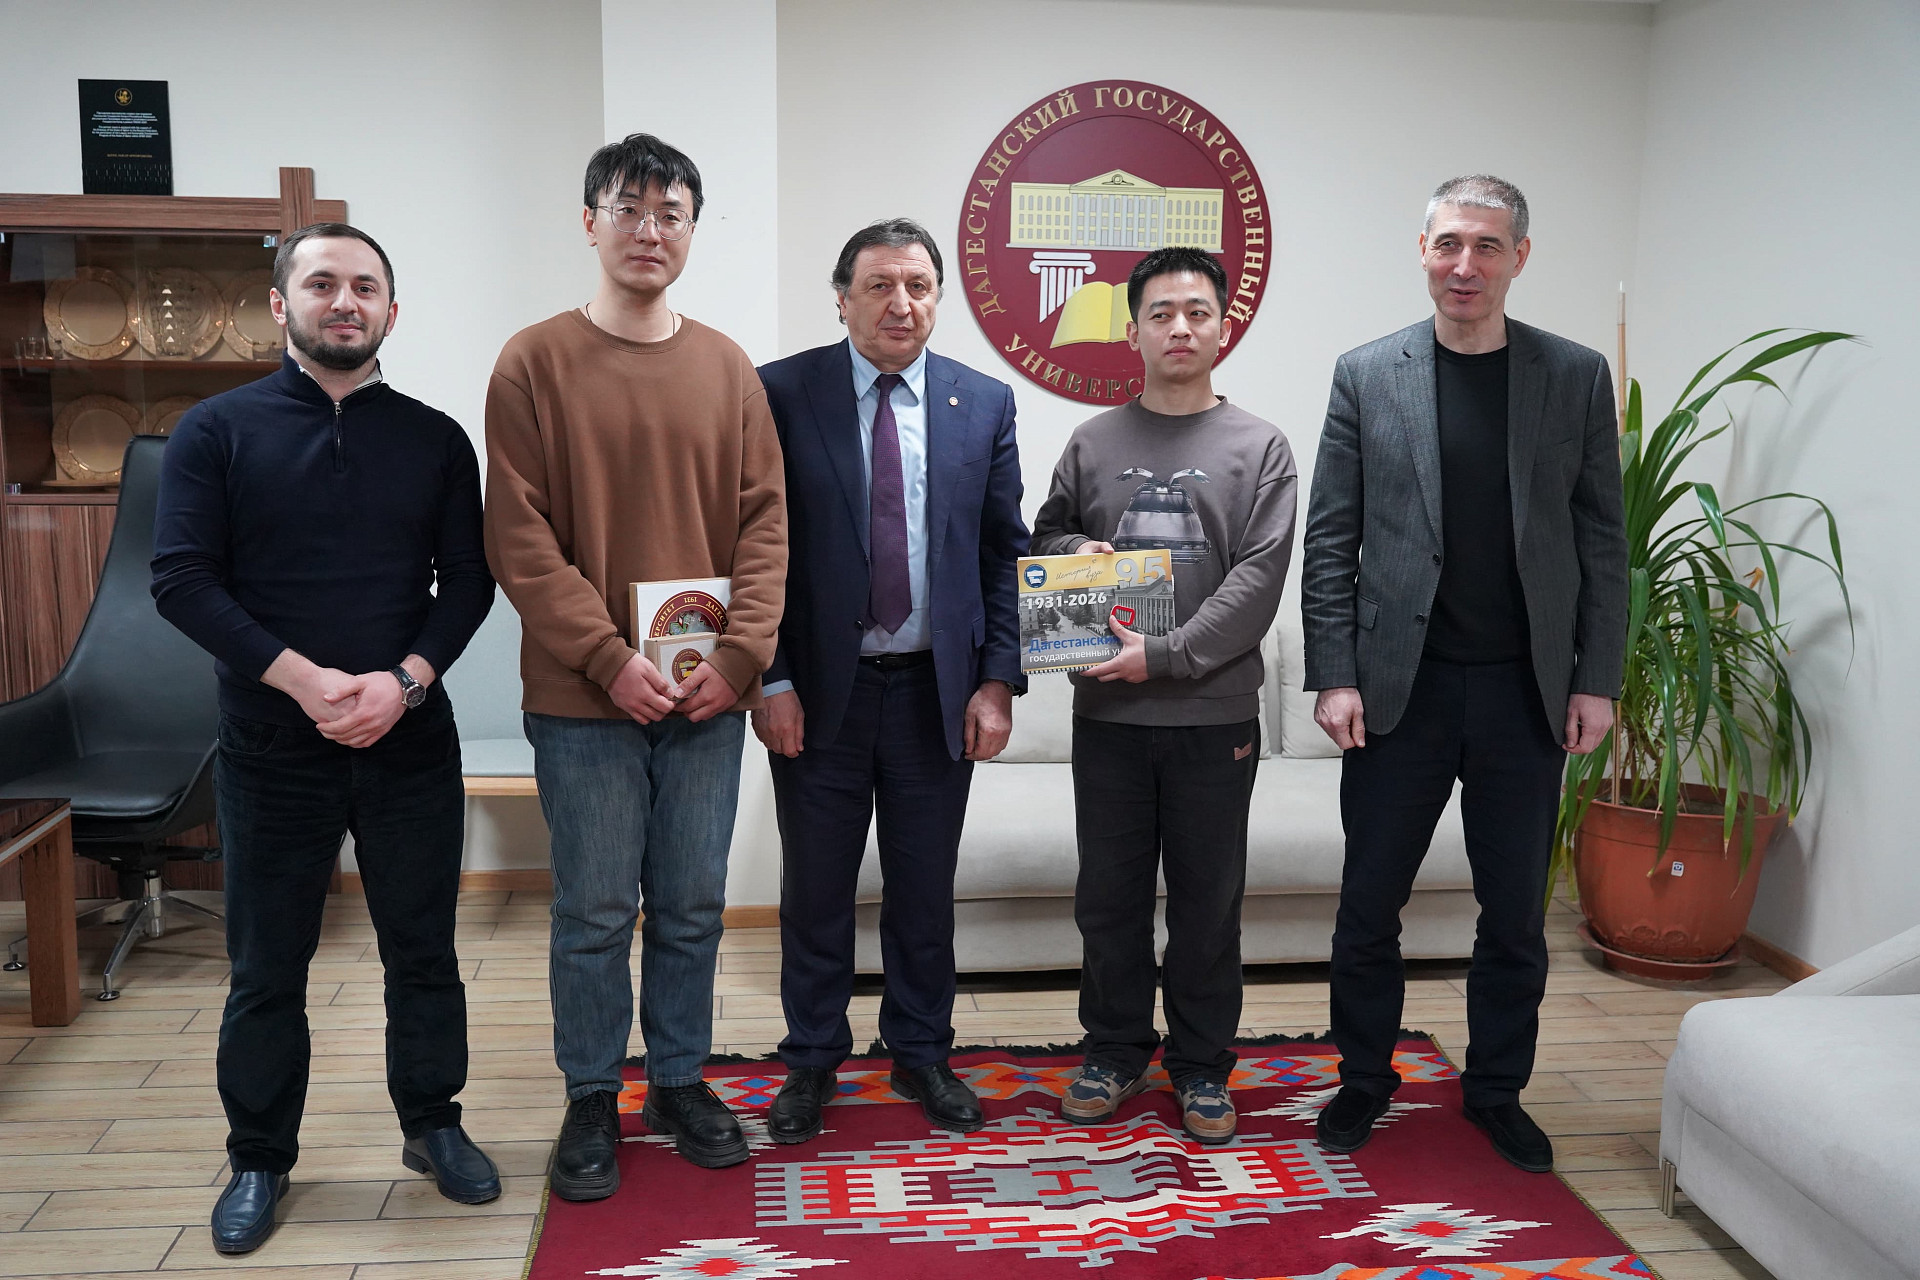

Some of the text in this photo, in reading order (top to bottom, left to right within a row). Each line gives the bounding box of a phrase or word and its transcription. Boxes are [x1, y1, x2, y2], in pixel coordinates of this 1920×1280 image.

[966, 86, 1265, 324] ДАГЕСТАНСКИЙ ГОСУДАРСТВЕННЫЙ
[1004, 333, 1143, 399] УНИВЕРС
[1115, 556, 1166, 589] 95
[1026, 592, 1107, 610] 1931-2026
[1029, 648, 1110, 663] государственный
